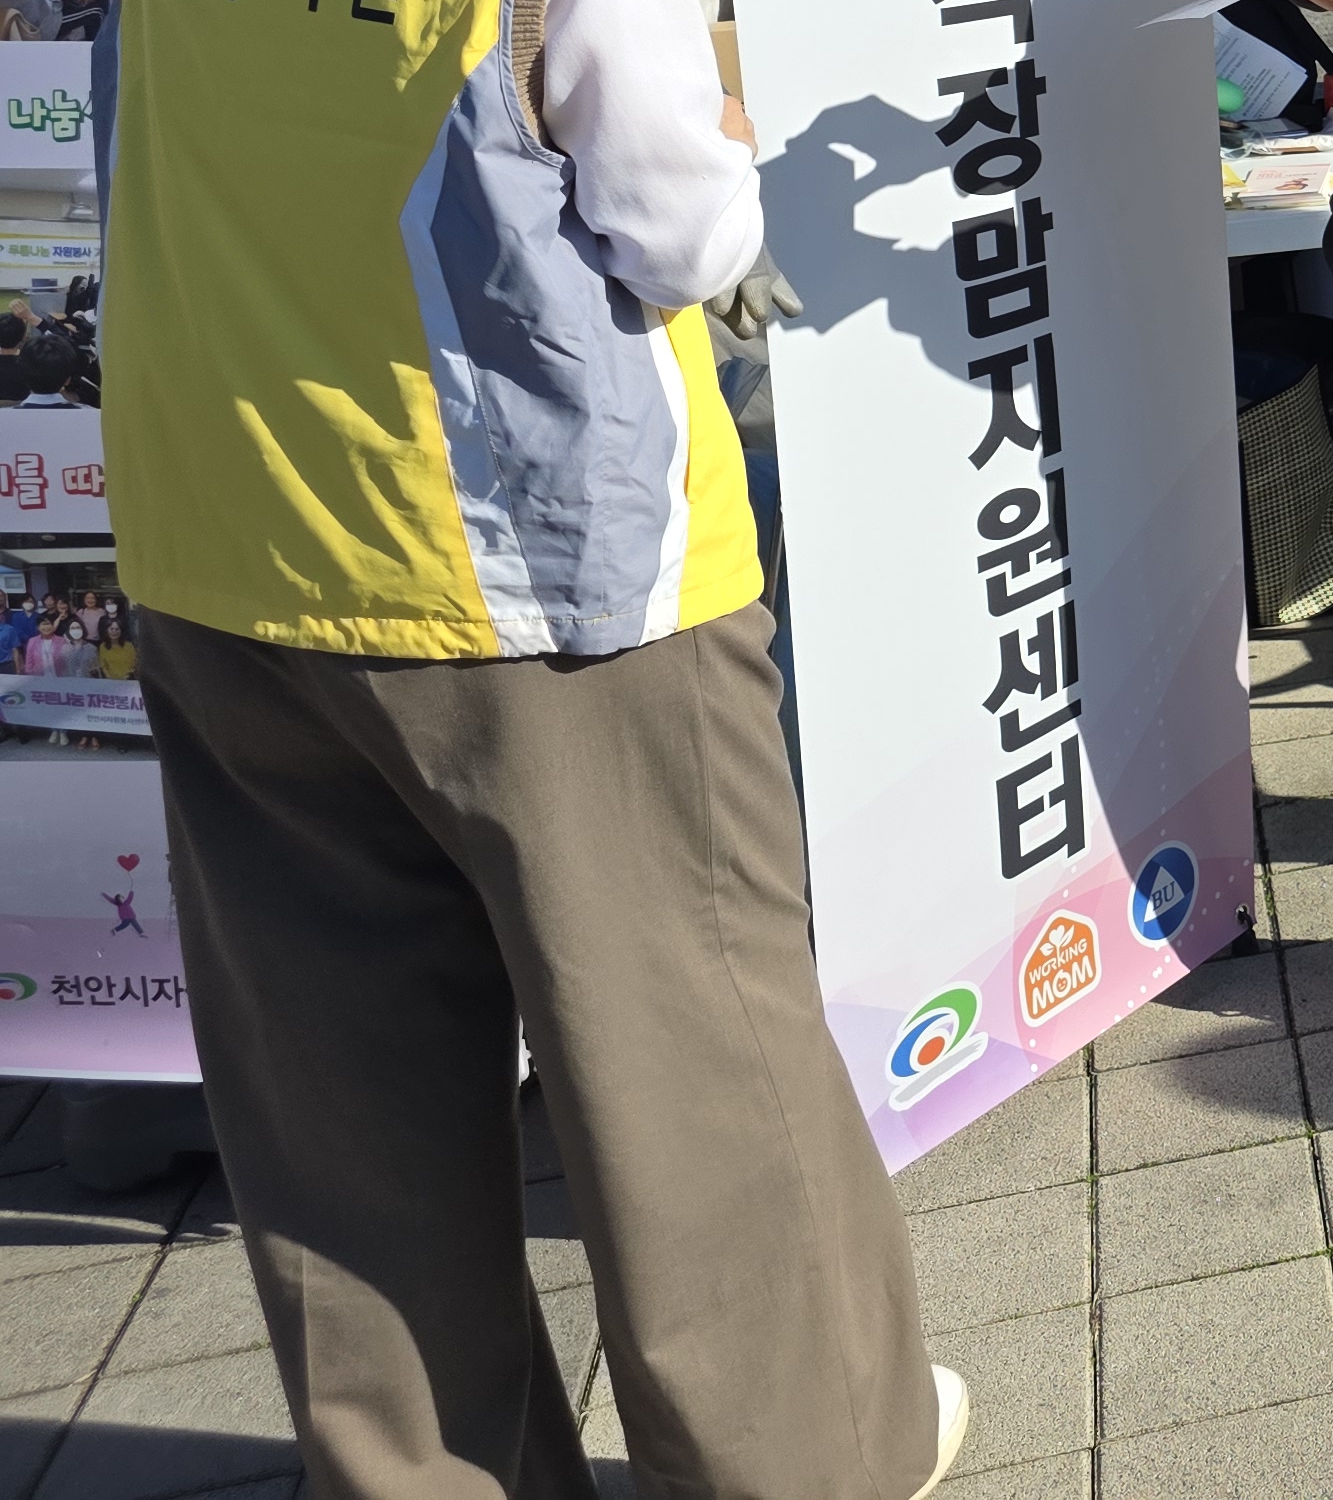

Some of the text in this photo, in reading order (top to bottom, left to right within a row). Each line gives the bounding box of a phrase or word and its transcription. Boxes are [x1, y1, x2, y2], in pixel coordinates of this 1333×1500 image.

[87, 692, 146, 711] 자원봉사
[1151, 880, 1175, 911] BU
[1029, 937, 1088, 985] WORKING
[51, 975, 186, 1008] 천안시자
[1032, 954, 1094, 1016] MOM
